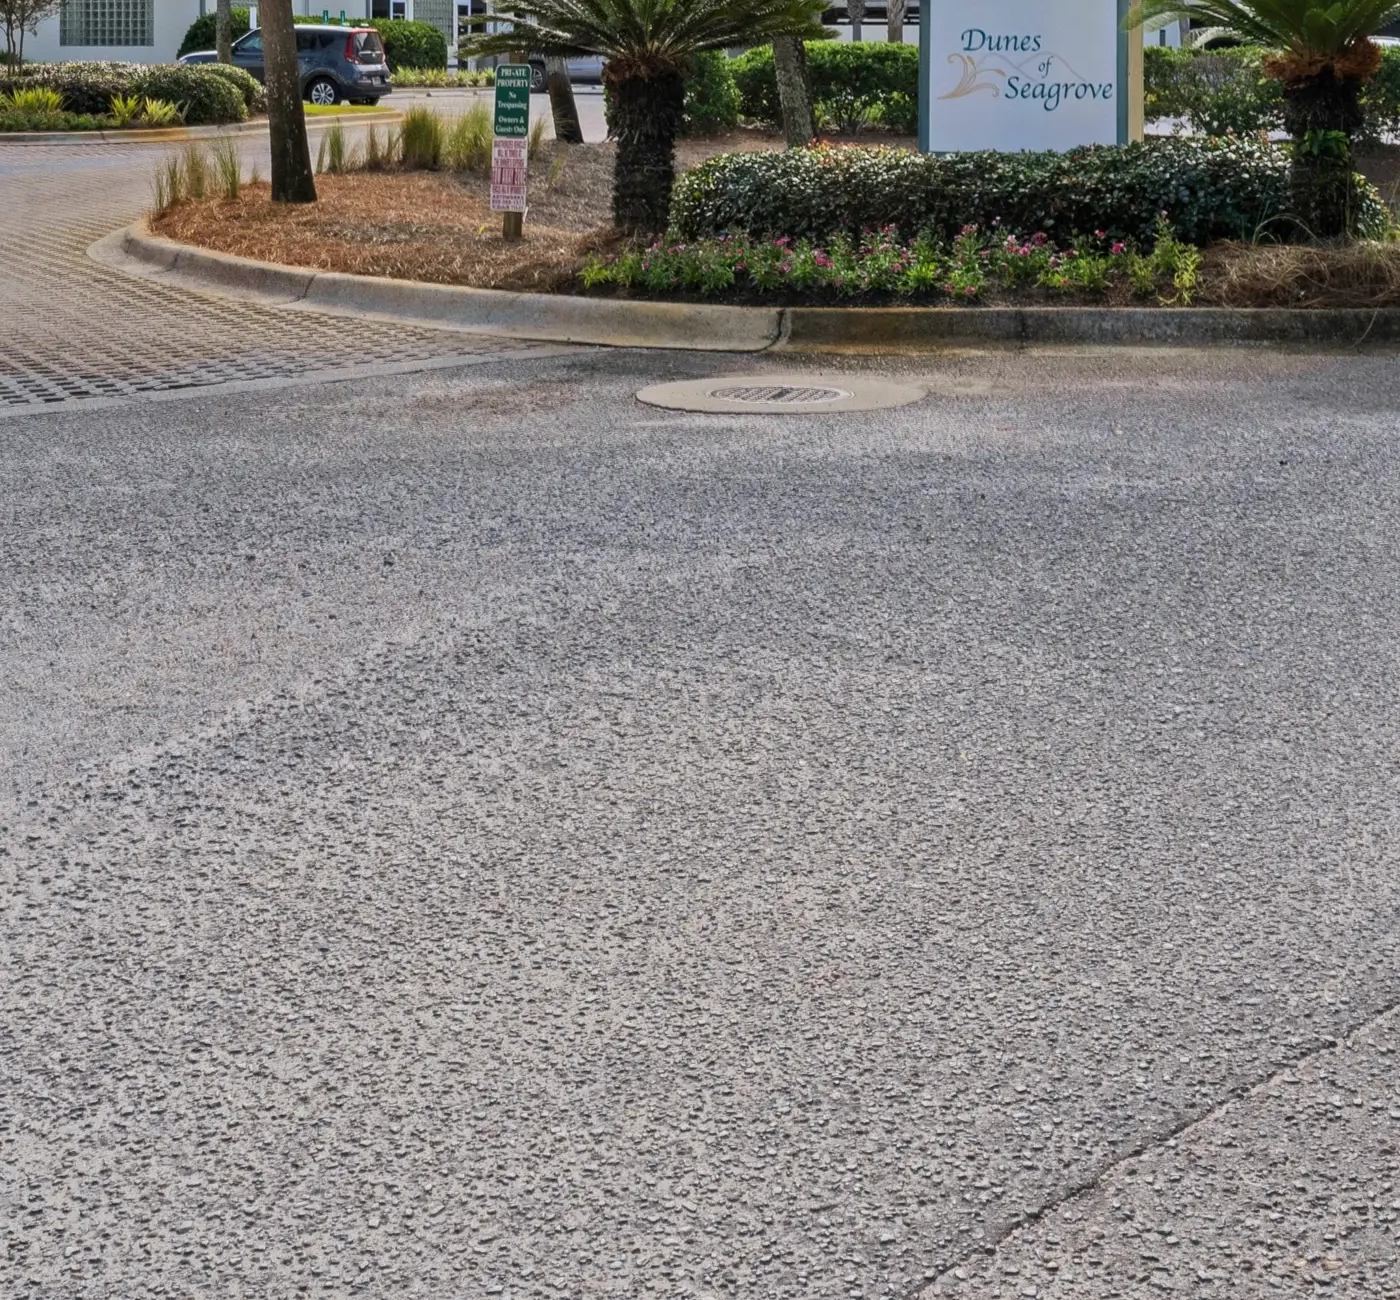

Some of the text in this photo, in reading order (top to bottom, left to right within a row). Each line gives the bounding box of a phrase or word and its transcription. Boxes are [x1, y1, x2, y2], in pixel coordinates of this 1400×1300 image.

[960, 28, 1042, 52] Dunes
[1037, 55, 1054, 80] of
[497, 79, 528, 88] PROPERTY
[509, 91, 517, 99] No
[1004, 76, 1114, 112] Seagrove
[497, 100, 527, 110] Trespassing
[498, 115, 525, 124] Owners &
[513, 125, 527, 135] Only
